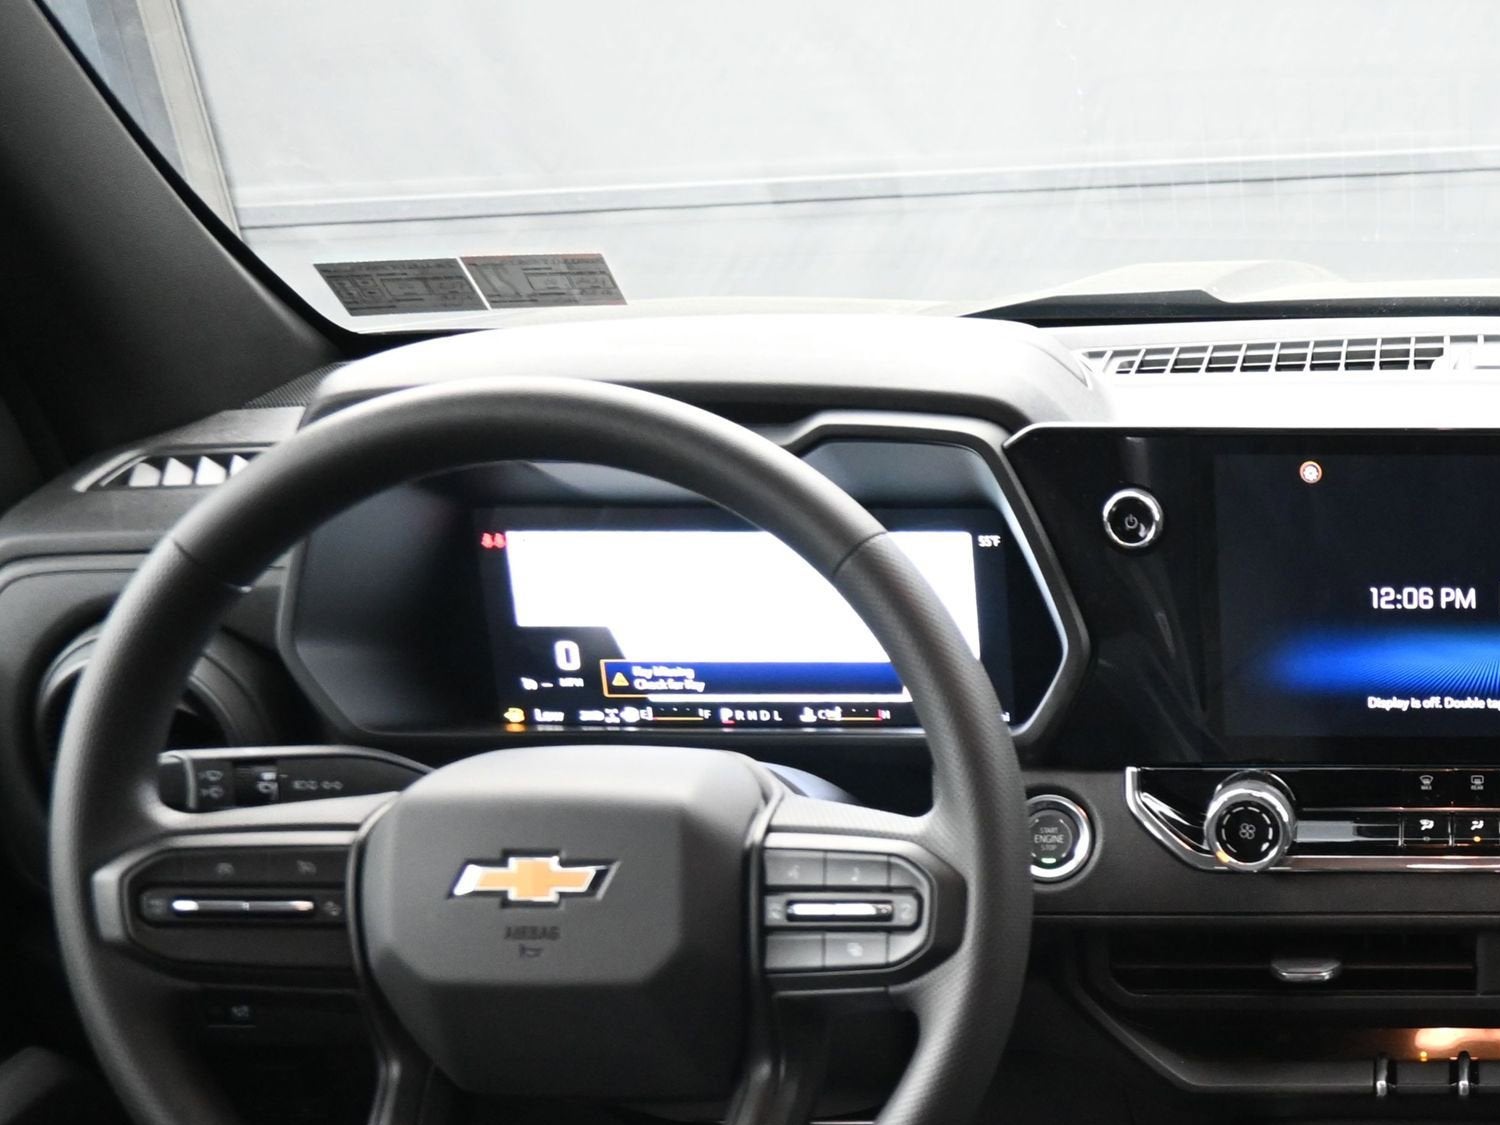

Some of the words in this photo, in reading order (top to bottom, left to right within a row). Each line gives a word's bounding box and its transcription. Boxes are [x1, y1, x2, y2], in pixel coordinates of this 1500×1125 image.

[1370, 587, 1434, 609] 12:06
[1440, 587, 1477, 609] PM
[554, 640, 581, 671] 0
[1367, 697, 1409, 711] Display
[1444, 697, 1485, 709] Double
[774, 711, 783, 721] L
[1034, 835, 1064, 843] ENGINE
